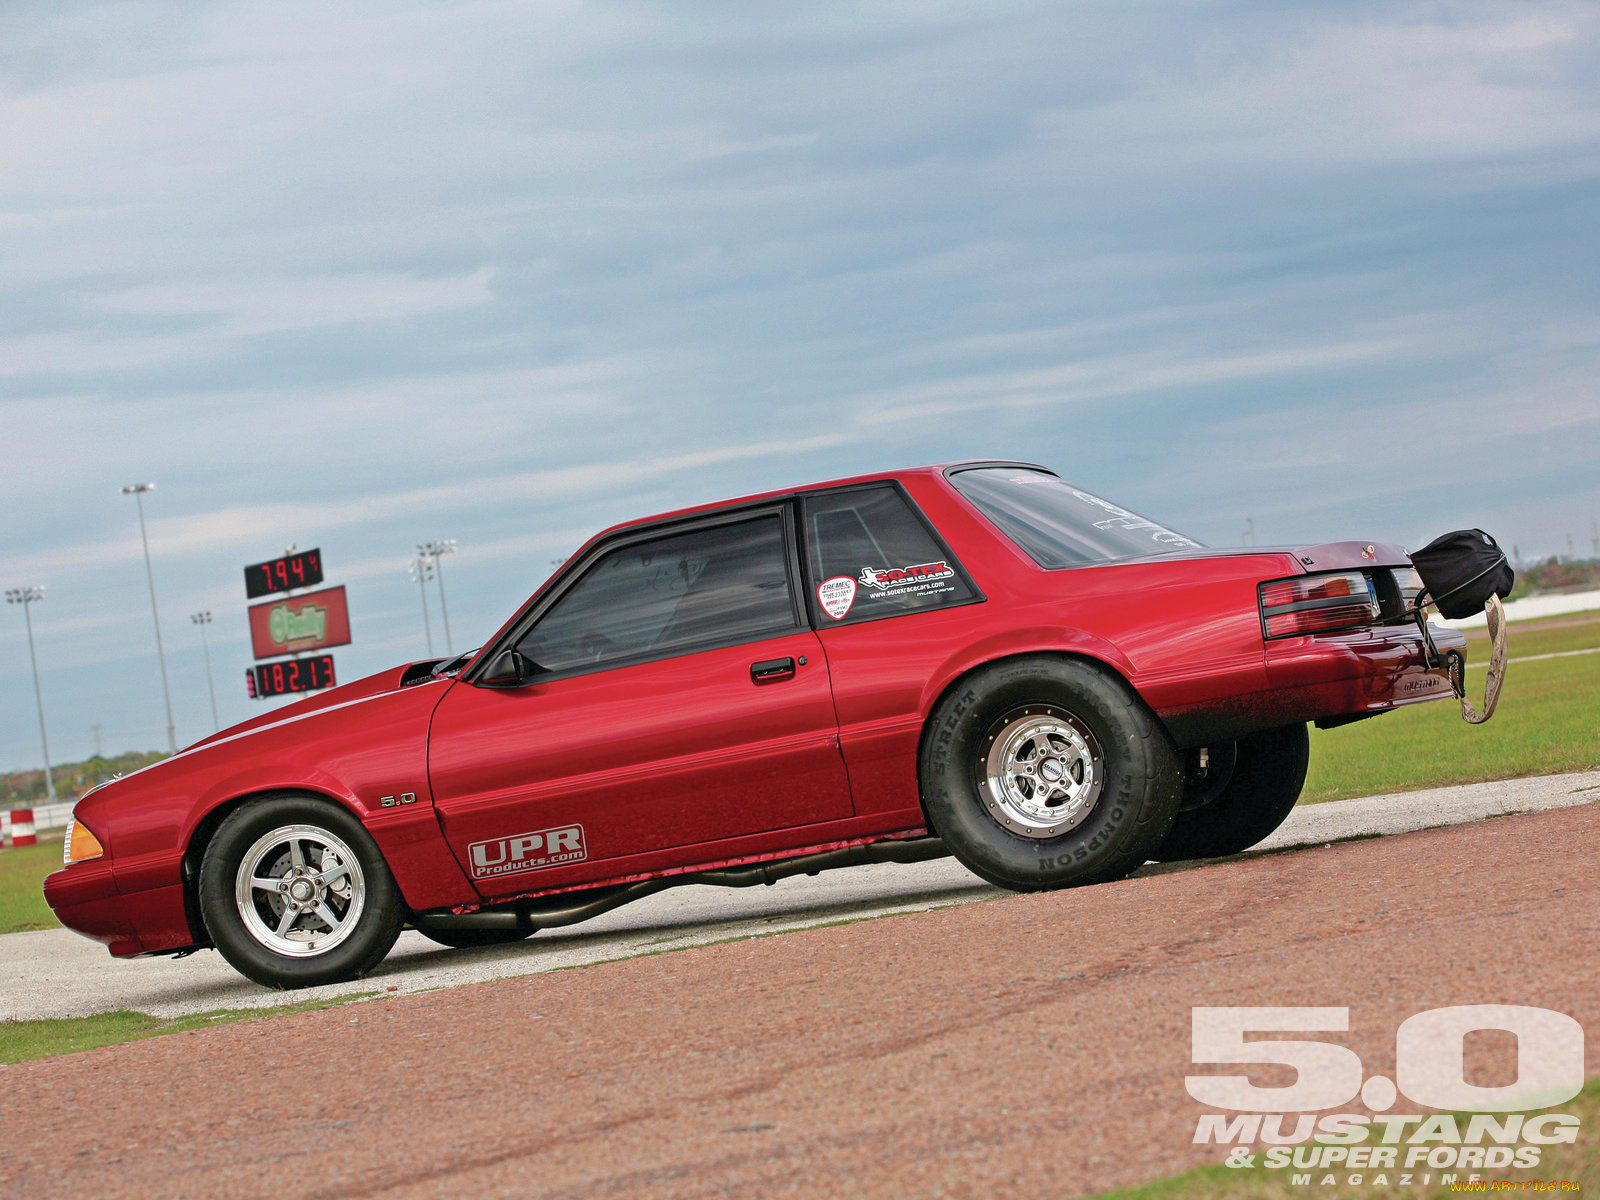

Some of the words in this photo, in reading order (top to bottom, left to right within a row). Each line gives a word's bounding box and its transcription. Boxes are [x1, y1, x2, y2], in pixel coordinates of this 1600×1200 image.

[875, 563, 950, 583] SO-TEX
[880, 577, 915, 589] RACE
[918, 570, 952, 580] CARS
[869, 581, 945, 599] www.sotexracecars.com
[262, 657, 335, 693] 182.13
[933, 689, 976, 777] STREET
[380, 792, 416, 807] 5.0
[1039, 774, 1132, 870] THOMPSON
[472, 828, 582, 867] UPR
[476, 850, 583, 876] Products.com
